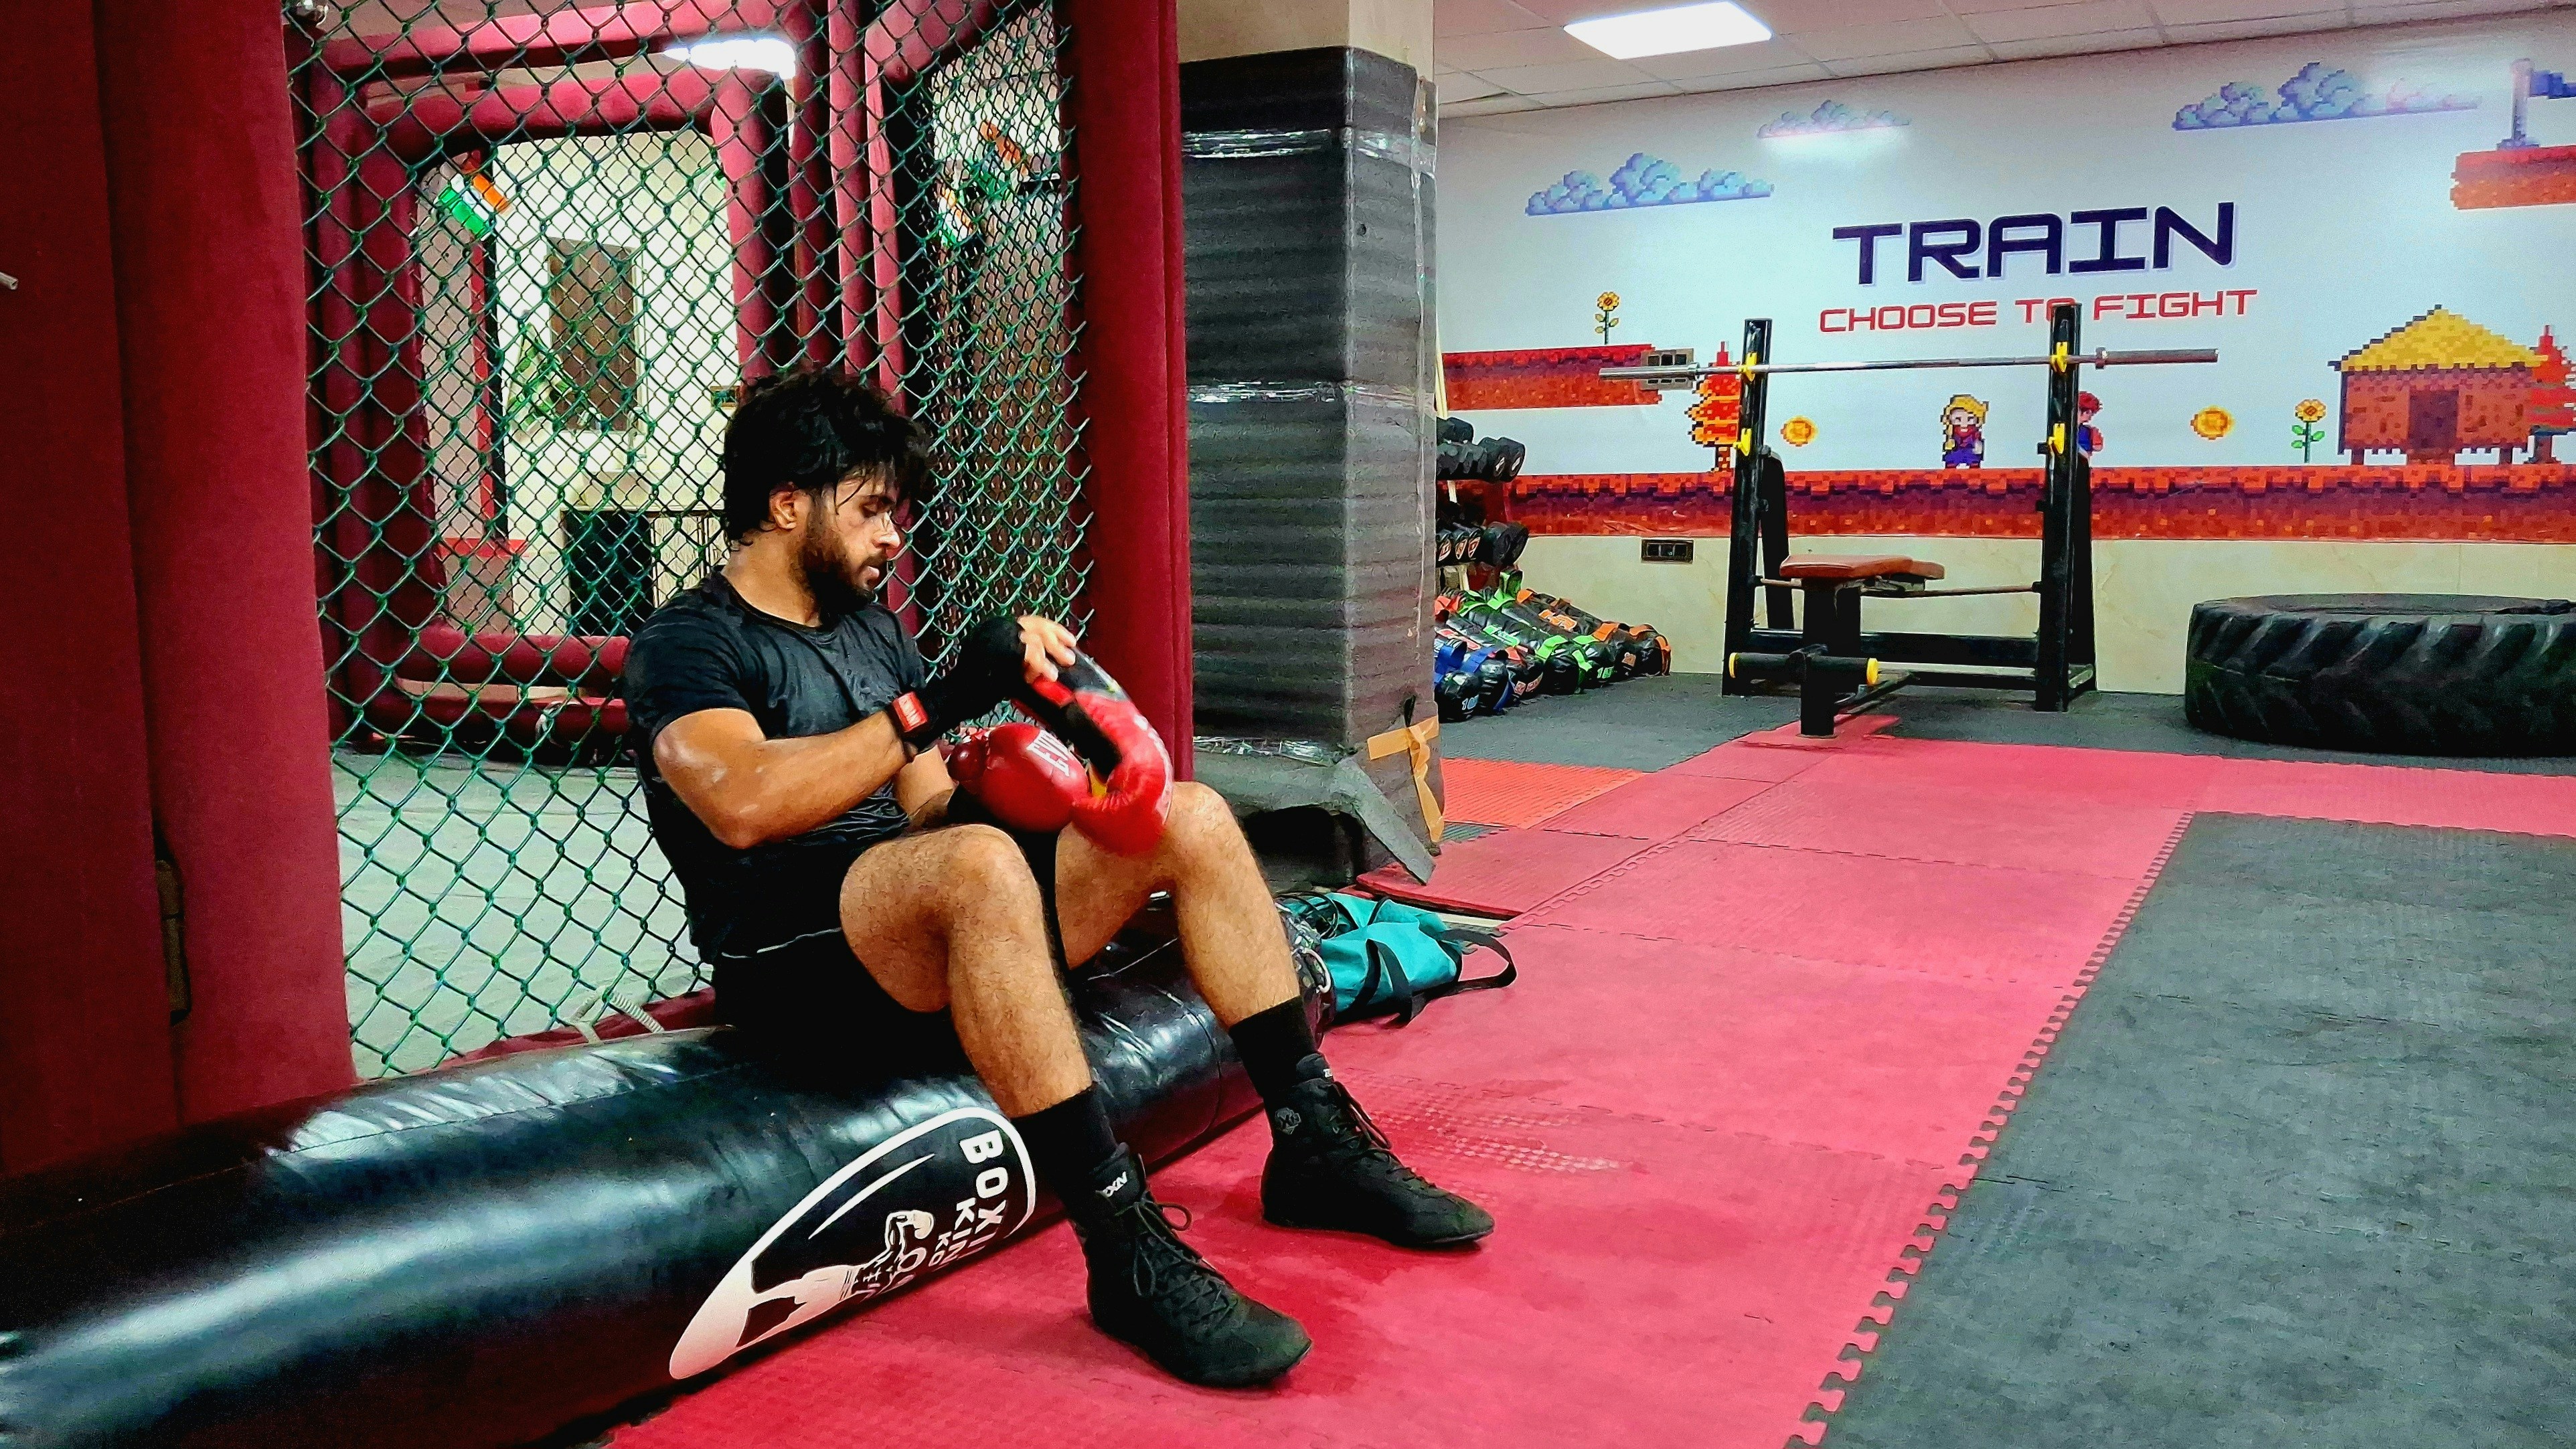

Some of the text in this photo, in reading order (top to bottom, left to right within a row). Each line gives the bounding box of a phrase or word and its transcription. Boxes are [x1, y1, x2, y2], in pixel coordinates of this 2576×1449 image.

[1832, 202, 2235, 284] TRAIN
[1820, 301, 1998, 333] CHOOSE
[2093, 289, 2258, 321] FIGHT
